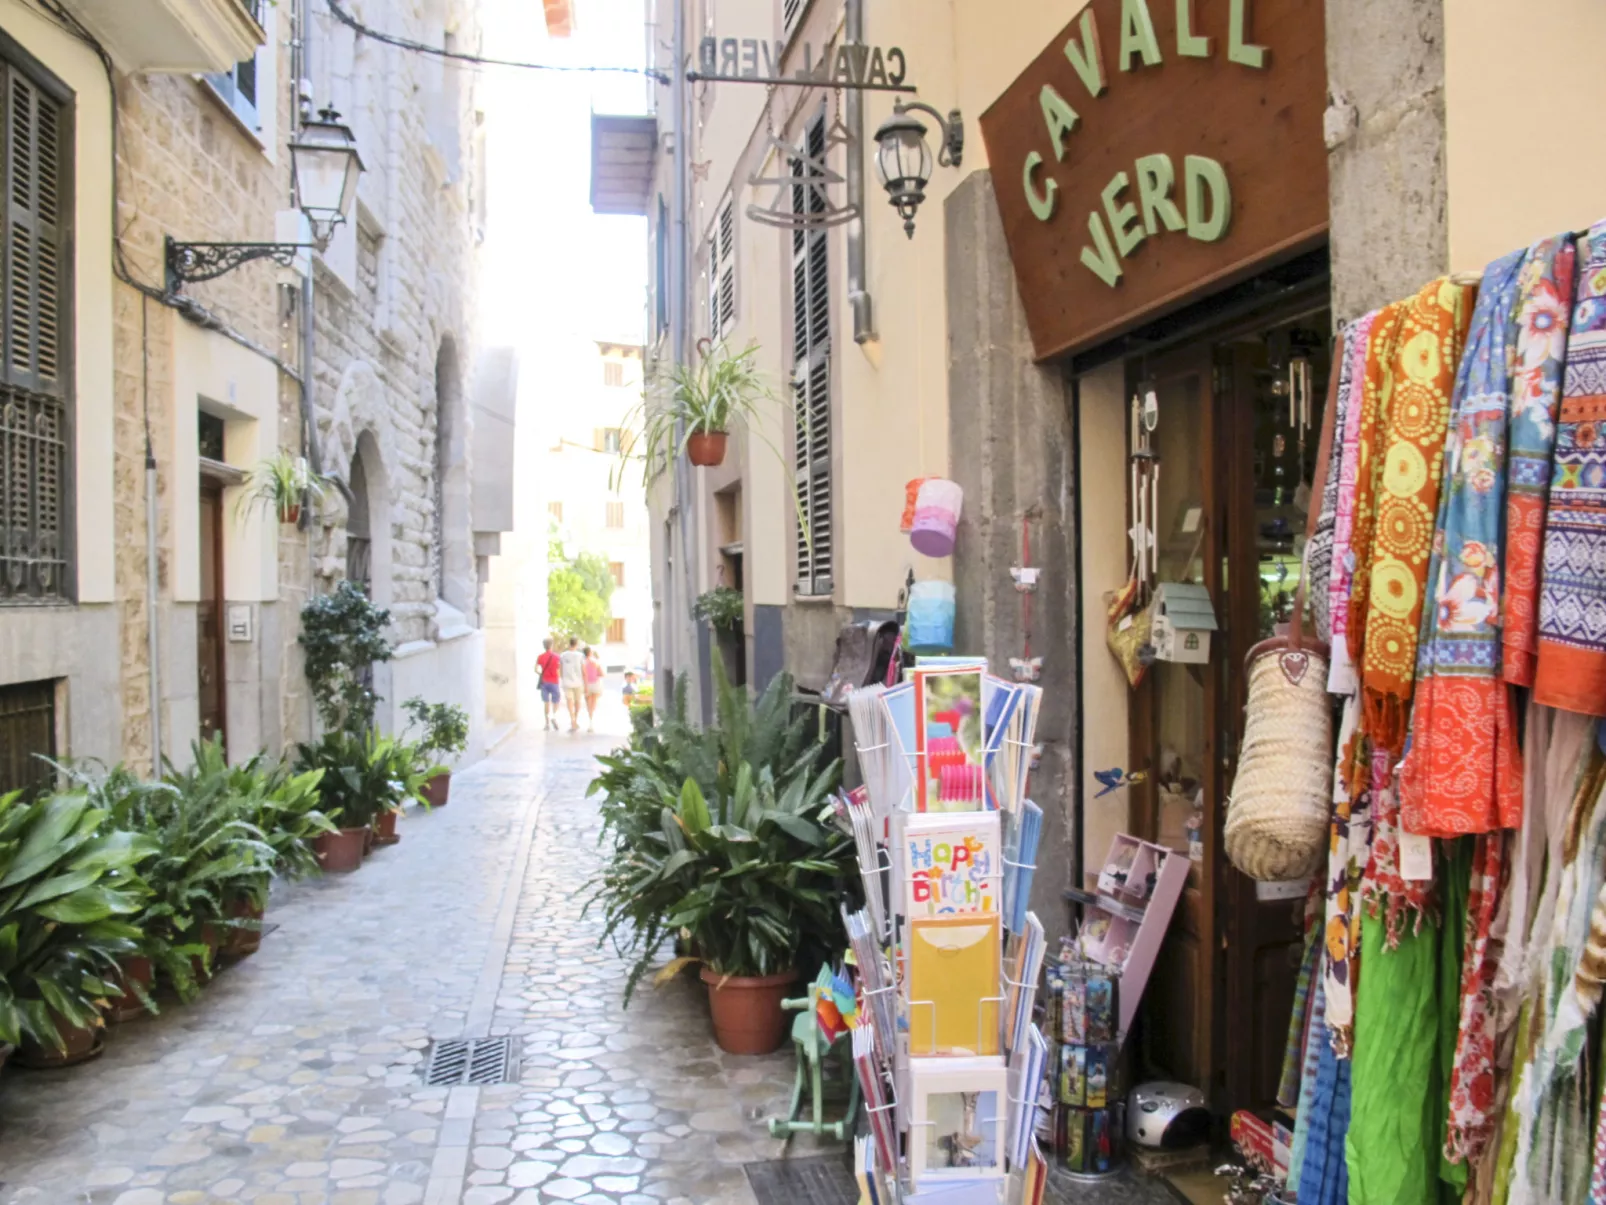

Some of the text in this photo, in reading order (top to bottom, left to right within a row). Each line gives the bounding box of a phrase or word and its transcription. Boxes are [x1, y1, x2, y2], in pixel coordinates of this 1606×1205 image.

[1023, 0, 1268, 221] CAVALL
[1080, 153, 1232, 288] VERD
[909, 836, 991, 883] Happy
